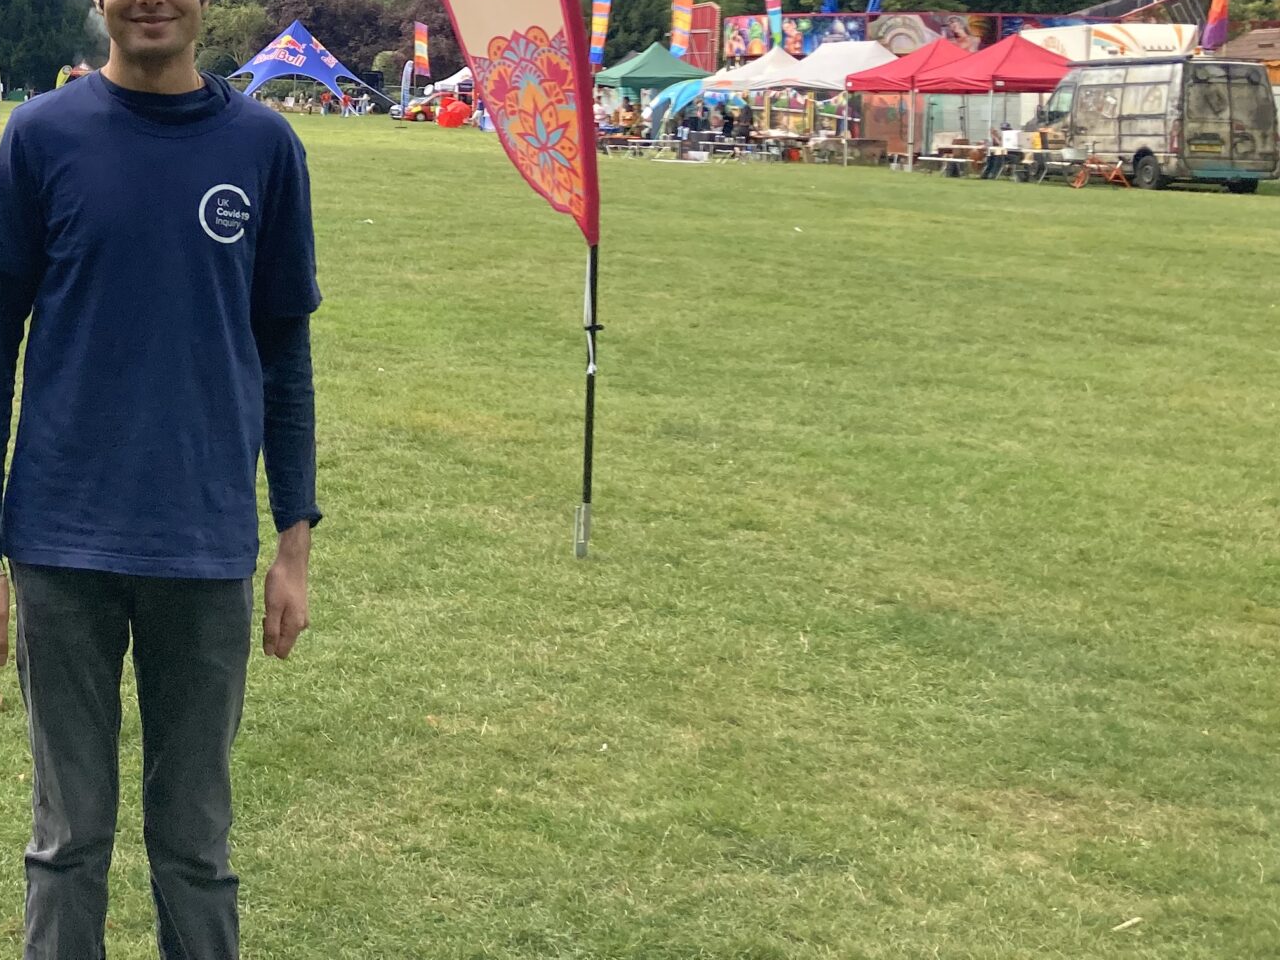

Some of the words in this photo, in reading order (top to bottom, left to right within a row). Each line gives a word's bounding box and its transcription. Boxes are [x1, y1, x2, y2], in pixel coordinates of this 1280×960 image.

[277, 48, 307, 67] Bull
[217, 198, 230, 208] UK
[216, 207, 250, 221] Covid-19
[215, 217, 241, 229] Inquiry
